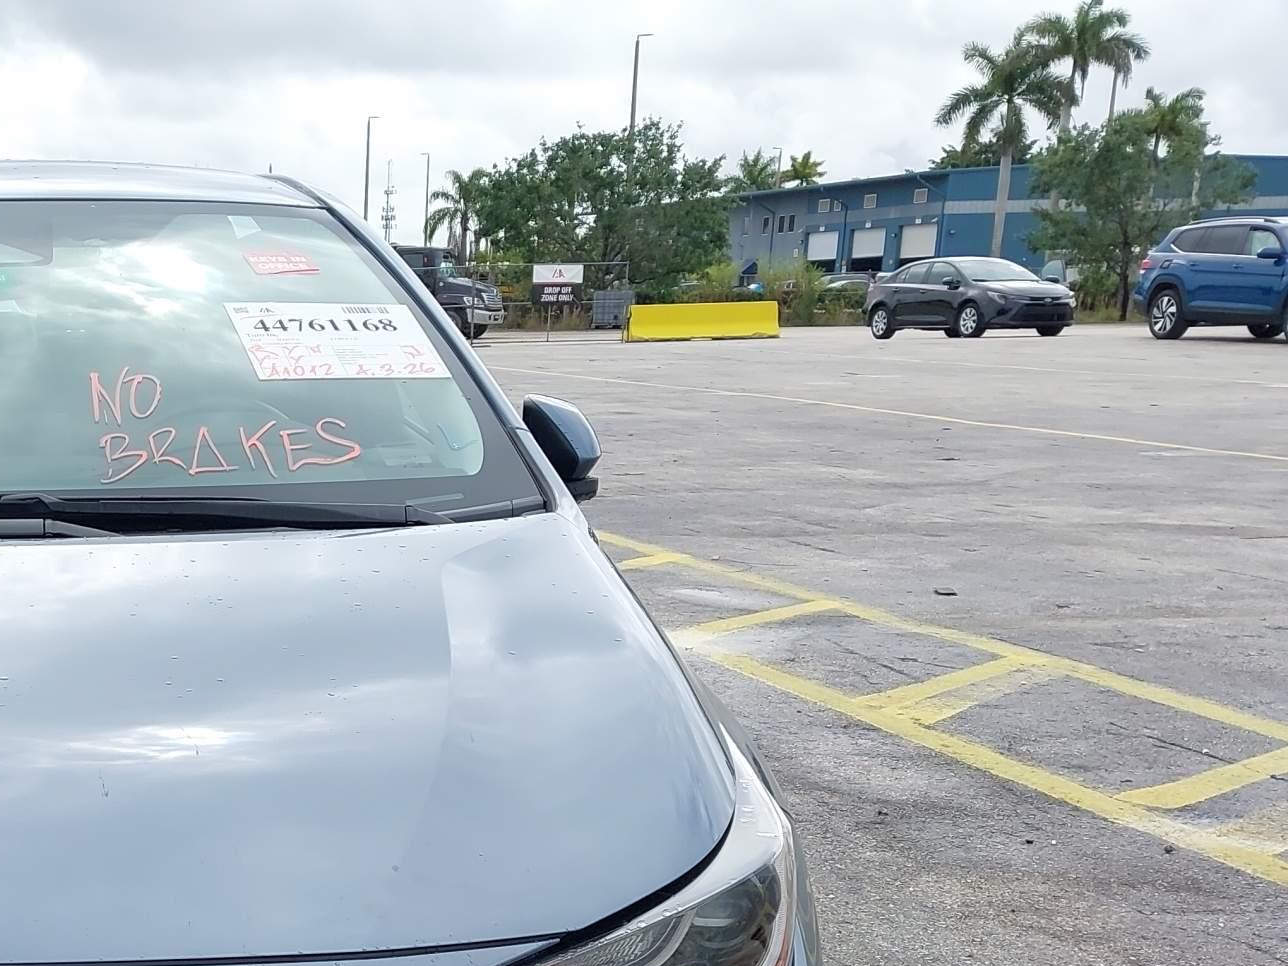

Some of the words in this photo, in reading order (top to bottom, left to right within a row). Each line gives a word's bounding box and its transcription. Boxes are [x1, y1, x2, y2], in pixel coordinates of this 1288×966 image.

[543, 286, 560, 294] DROP
[561, 286, 573, 294] OFF
[540, 294, 558, 302] ZONE
[253, 318, 398, 332] 44761168
[88, 366, 162, 426] NO
[99, 417, 362, 484] BRAKES
